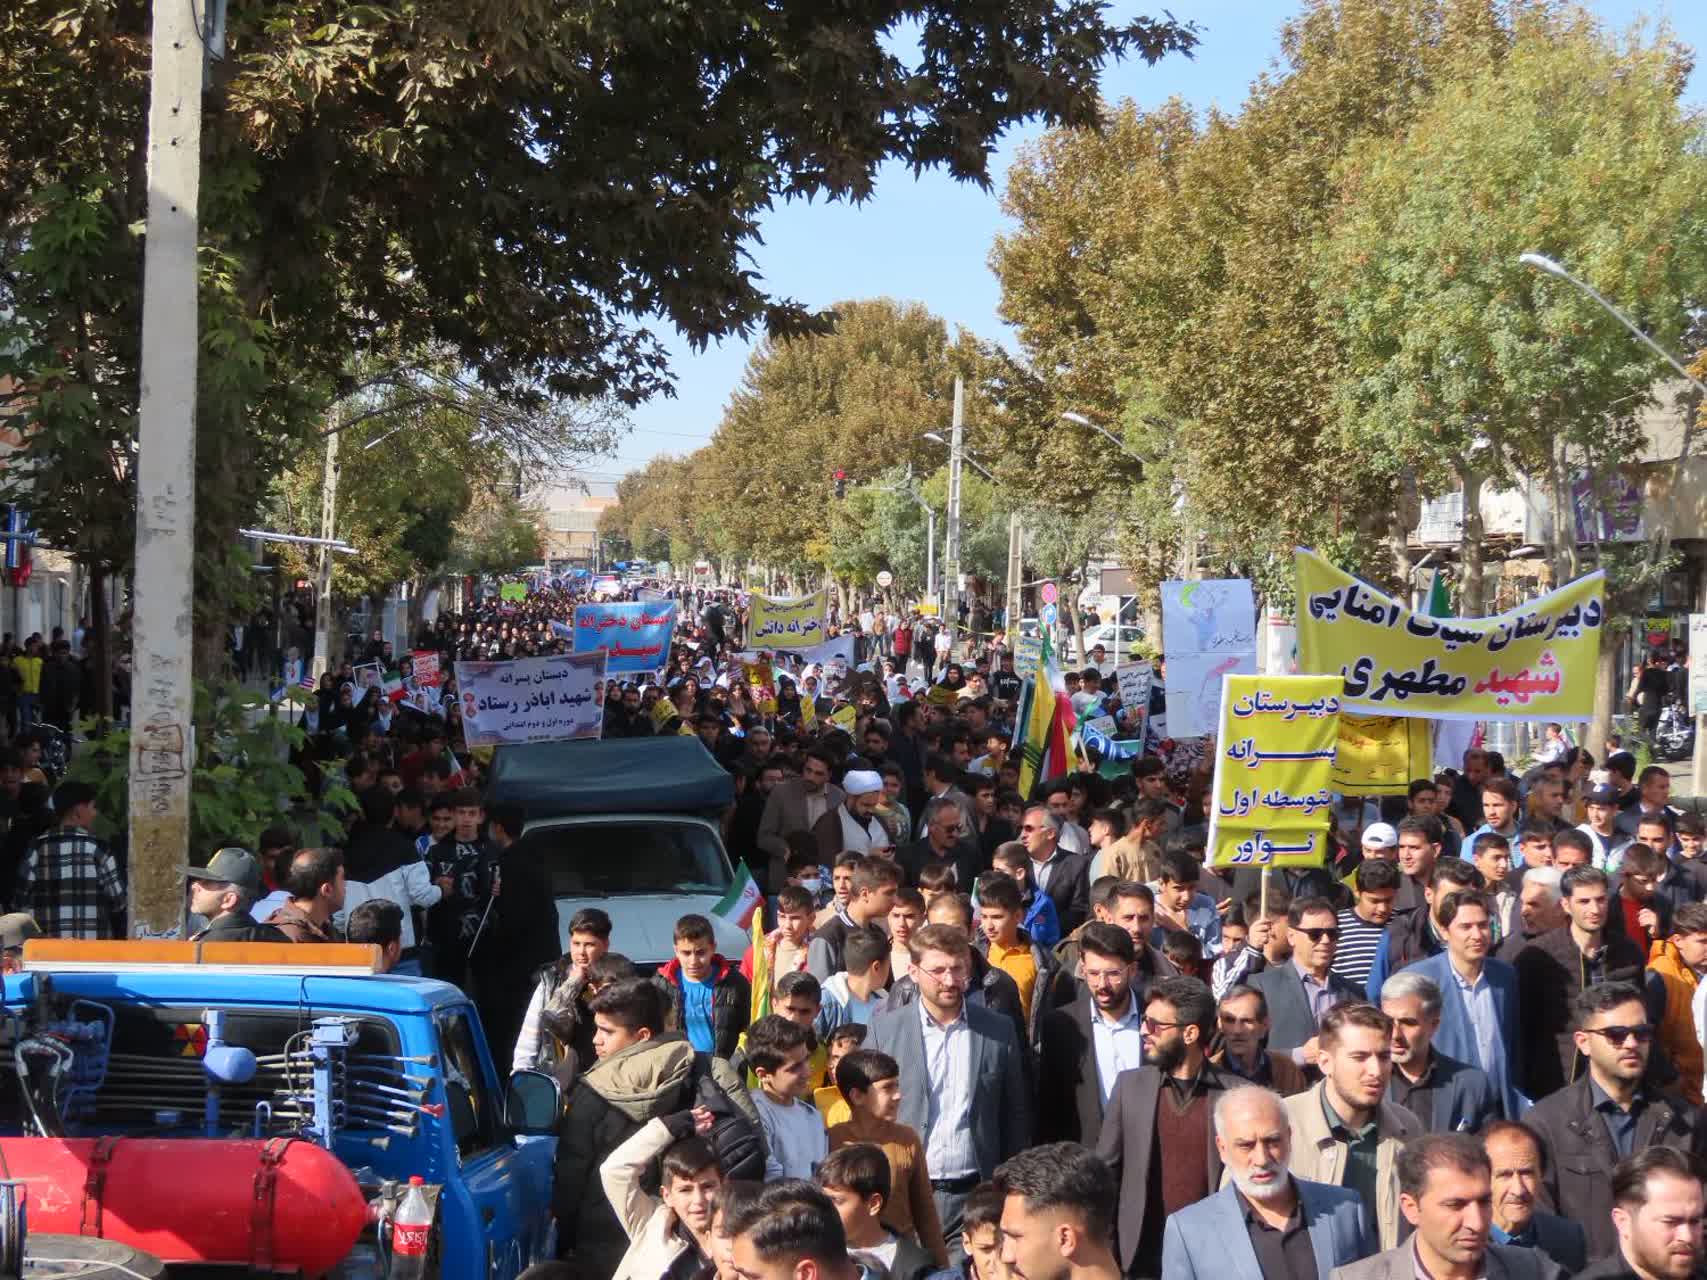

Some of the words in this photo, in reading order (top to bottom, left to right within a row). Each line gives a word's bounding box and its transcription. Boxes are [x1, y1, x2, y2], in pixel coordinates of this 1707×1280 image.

[1309, 584, 1399, 627] امنایی
[1488, 598, 1600, 651] دبیرستان
[500, 673, 530, 687] پسرانه
[1341, 656, 1467, 701] مطهری
[1474, 652, 1562, 705] شهید
[559, 687, 591, 708] شهید
[1233, 691, 1339, 719] دبیرستان
[1226, 738, 1337, 768] پسرانه
[1219, 789, 1256, 815] اول
[1231, 830, 1313, 862] نوآور
